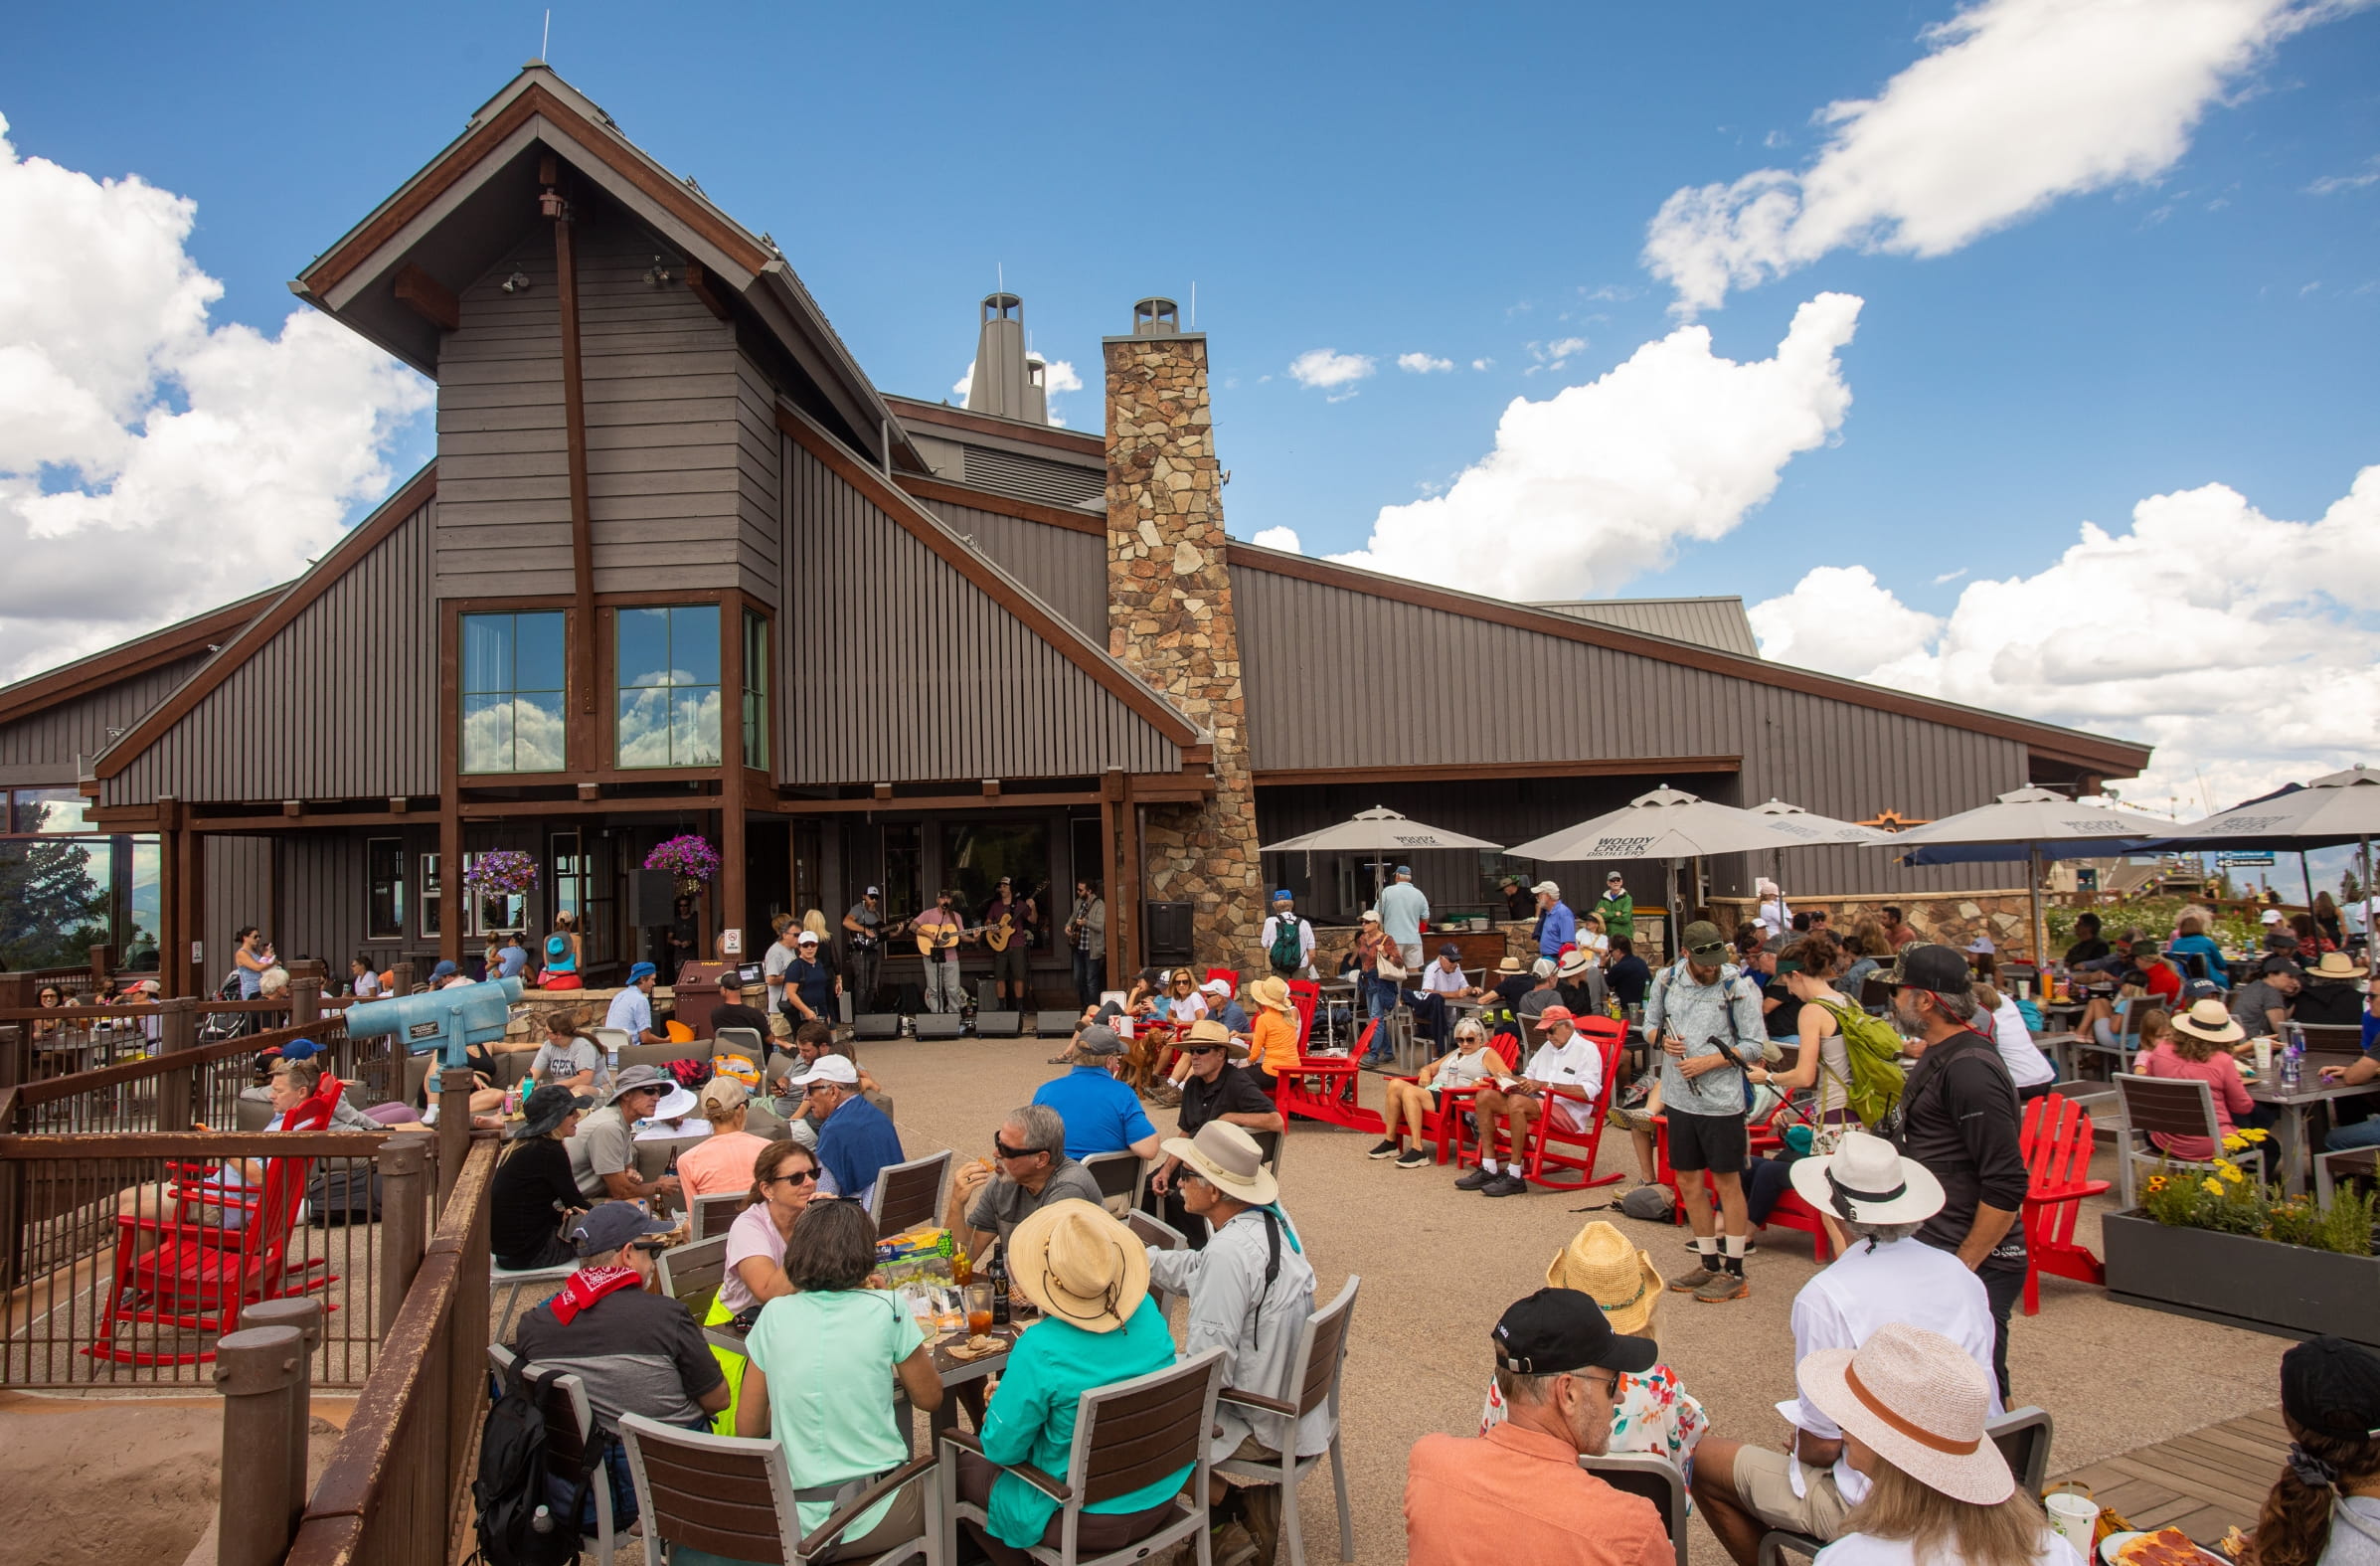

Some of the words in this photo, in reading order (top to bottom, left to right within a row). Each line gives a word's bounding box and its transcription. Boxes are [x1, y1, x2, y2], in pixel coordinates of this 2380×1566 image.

[1599, 836, 1655, 845] WOODY
[1594, 843, 1647, 852] CREEK
[549, 1059, 577, 1076] SPEN
